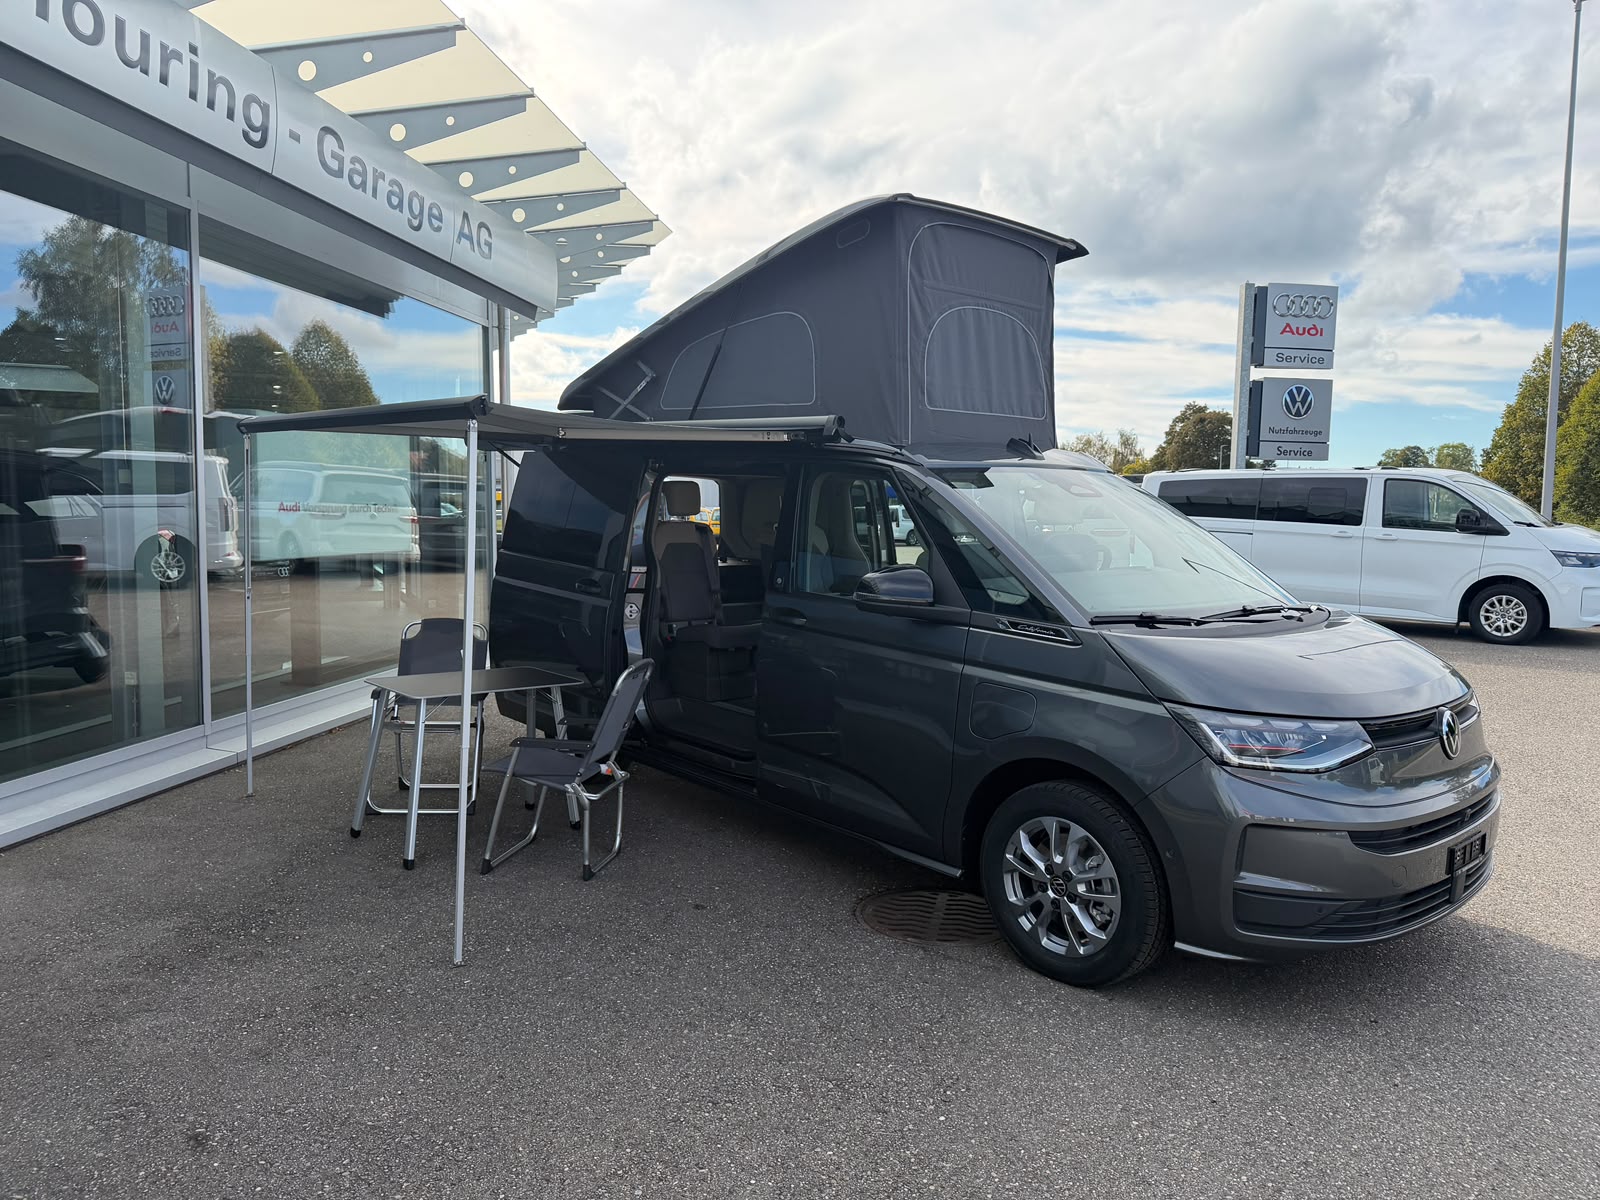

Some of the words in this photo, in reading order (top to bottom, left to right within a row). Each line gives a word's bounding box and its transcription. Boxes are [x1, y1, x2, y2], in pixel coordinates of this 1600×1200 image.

[316, 125, 444, 233] Garage
[455, 210, 493, 260] AG
[1279, 322, 1324, 338] Audi
[1275, 352, 1325, 365] Service
[1268, 426, 1323, 438] Nutzfahrzeuge
[1276, 446, 1313, 457] Service
[278, 501, 301, 512] Audi
[349, 503, 372, 513] durch
